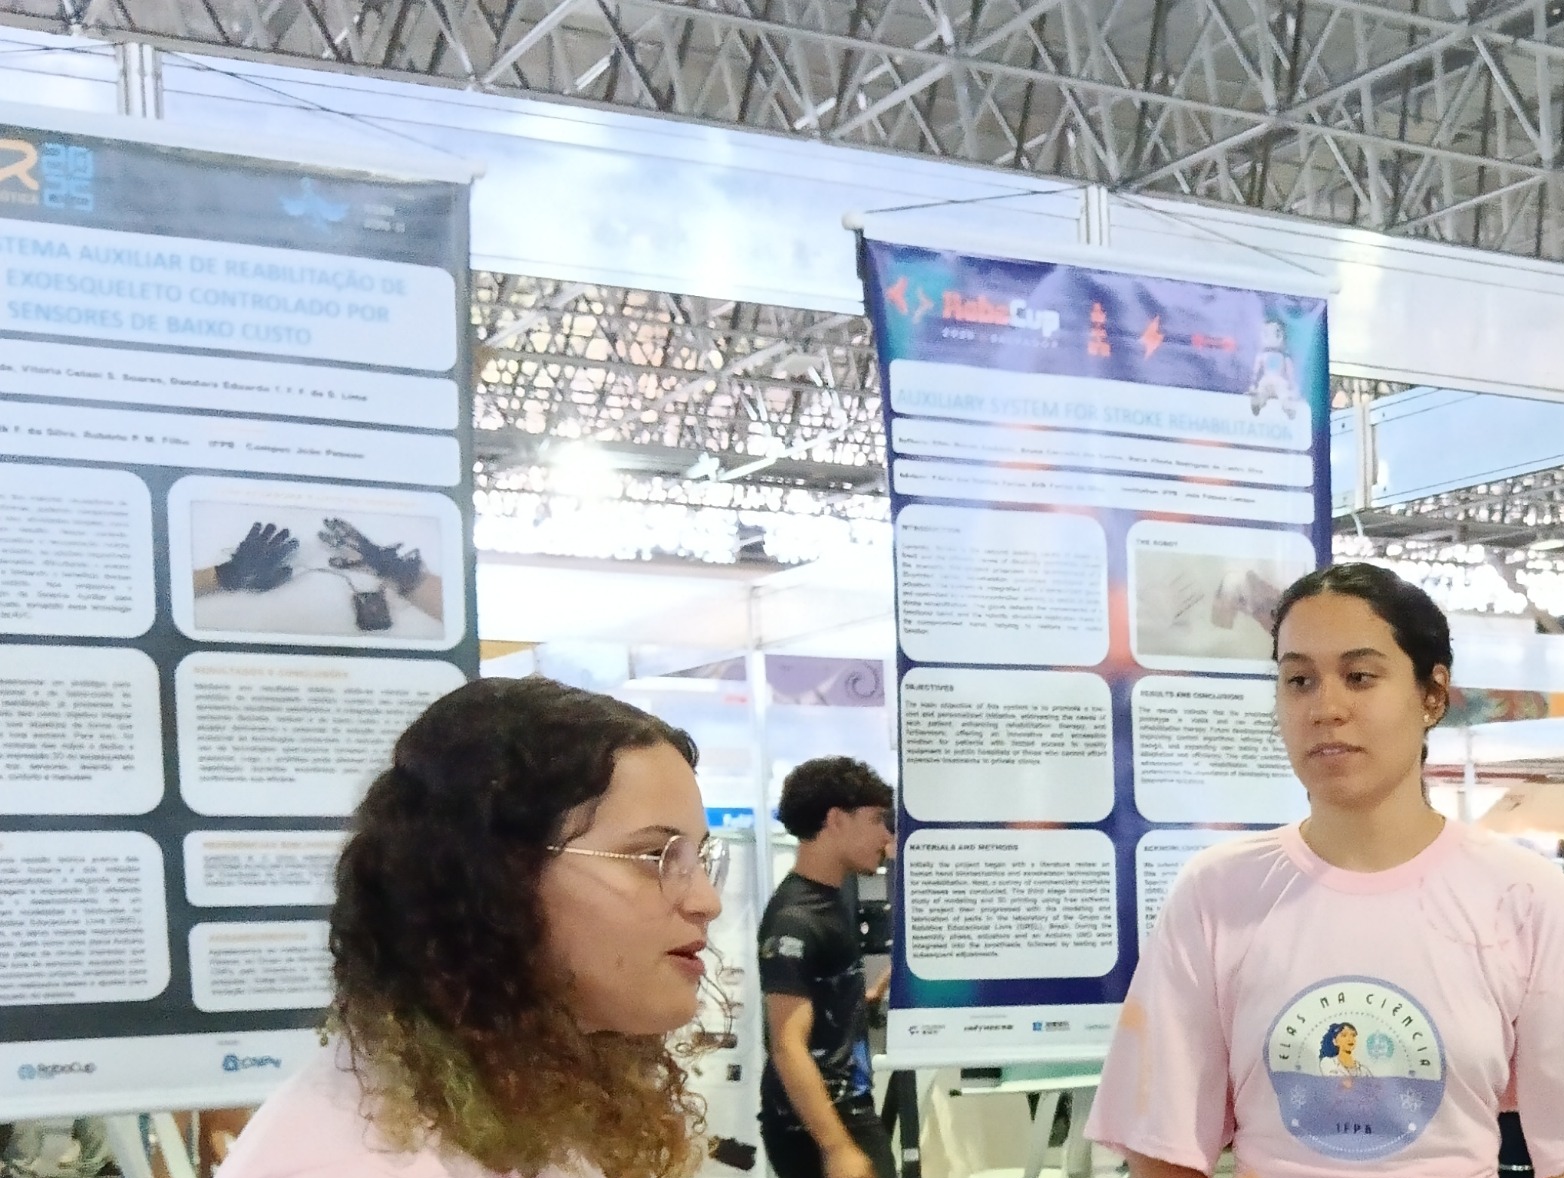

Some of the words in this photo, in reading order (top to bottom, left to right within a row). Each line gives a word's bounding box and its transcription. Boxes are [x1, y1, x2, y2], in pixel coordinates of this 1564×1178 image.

[0, 236, 71, 260] TEMA
[80, 244, 182, 271] AUXILIAR
[190, 256, 216, 274] DE
[227, 260, 374, 295] REABILITAÇÃO
[382, 278, 407, 296] DE
[6, 269, 182, 302] EXOESQUELETO
[190, 288, 339, 319] CONTROLADO
[348, 304, 390, 323] POR
[8, 301, 123, 329] SENSORES
[131, 312, 158, 331] DE
[168, 317, 234, 338] BAIXO
[242, 323, 311, 345] CUSTO
[896, 388, 984, 414] AUXILIARY
[990, 398, 1059, 420] SYSTEM
[1065, 405, 1098, 423] FOR
[1104, 407, 1163, 427] STROKE
[1168, 414, 1292, 440] REHABILITATION
[1279, 1014, 1306, 1060] ELAS
[1319, 992, 1345, 1008] NA
[1366, 994, 1431, 1067] CIÊNCIA
